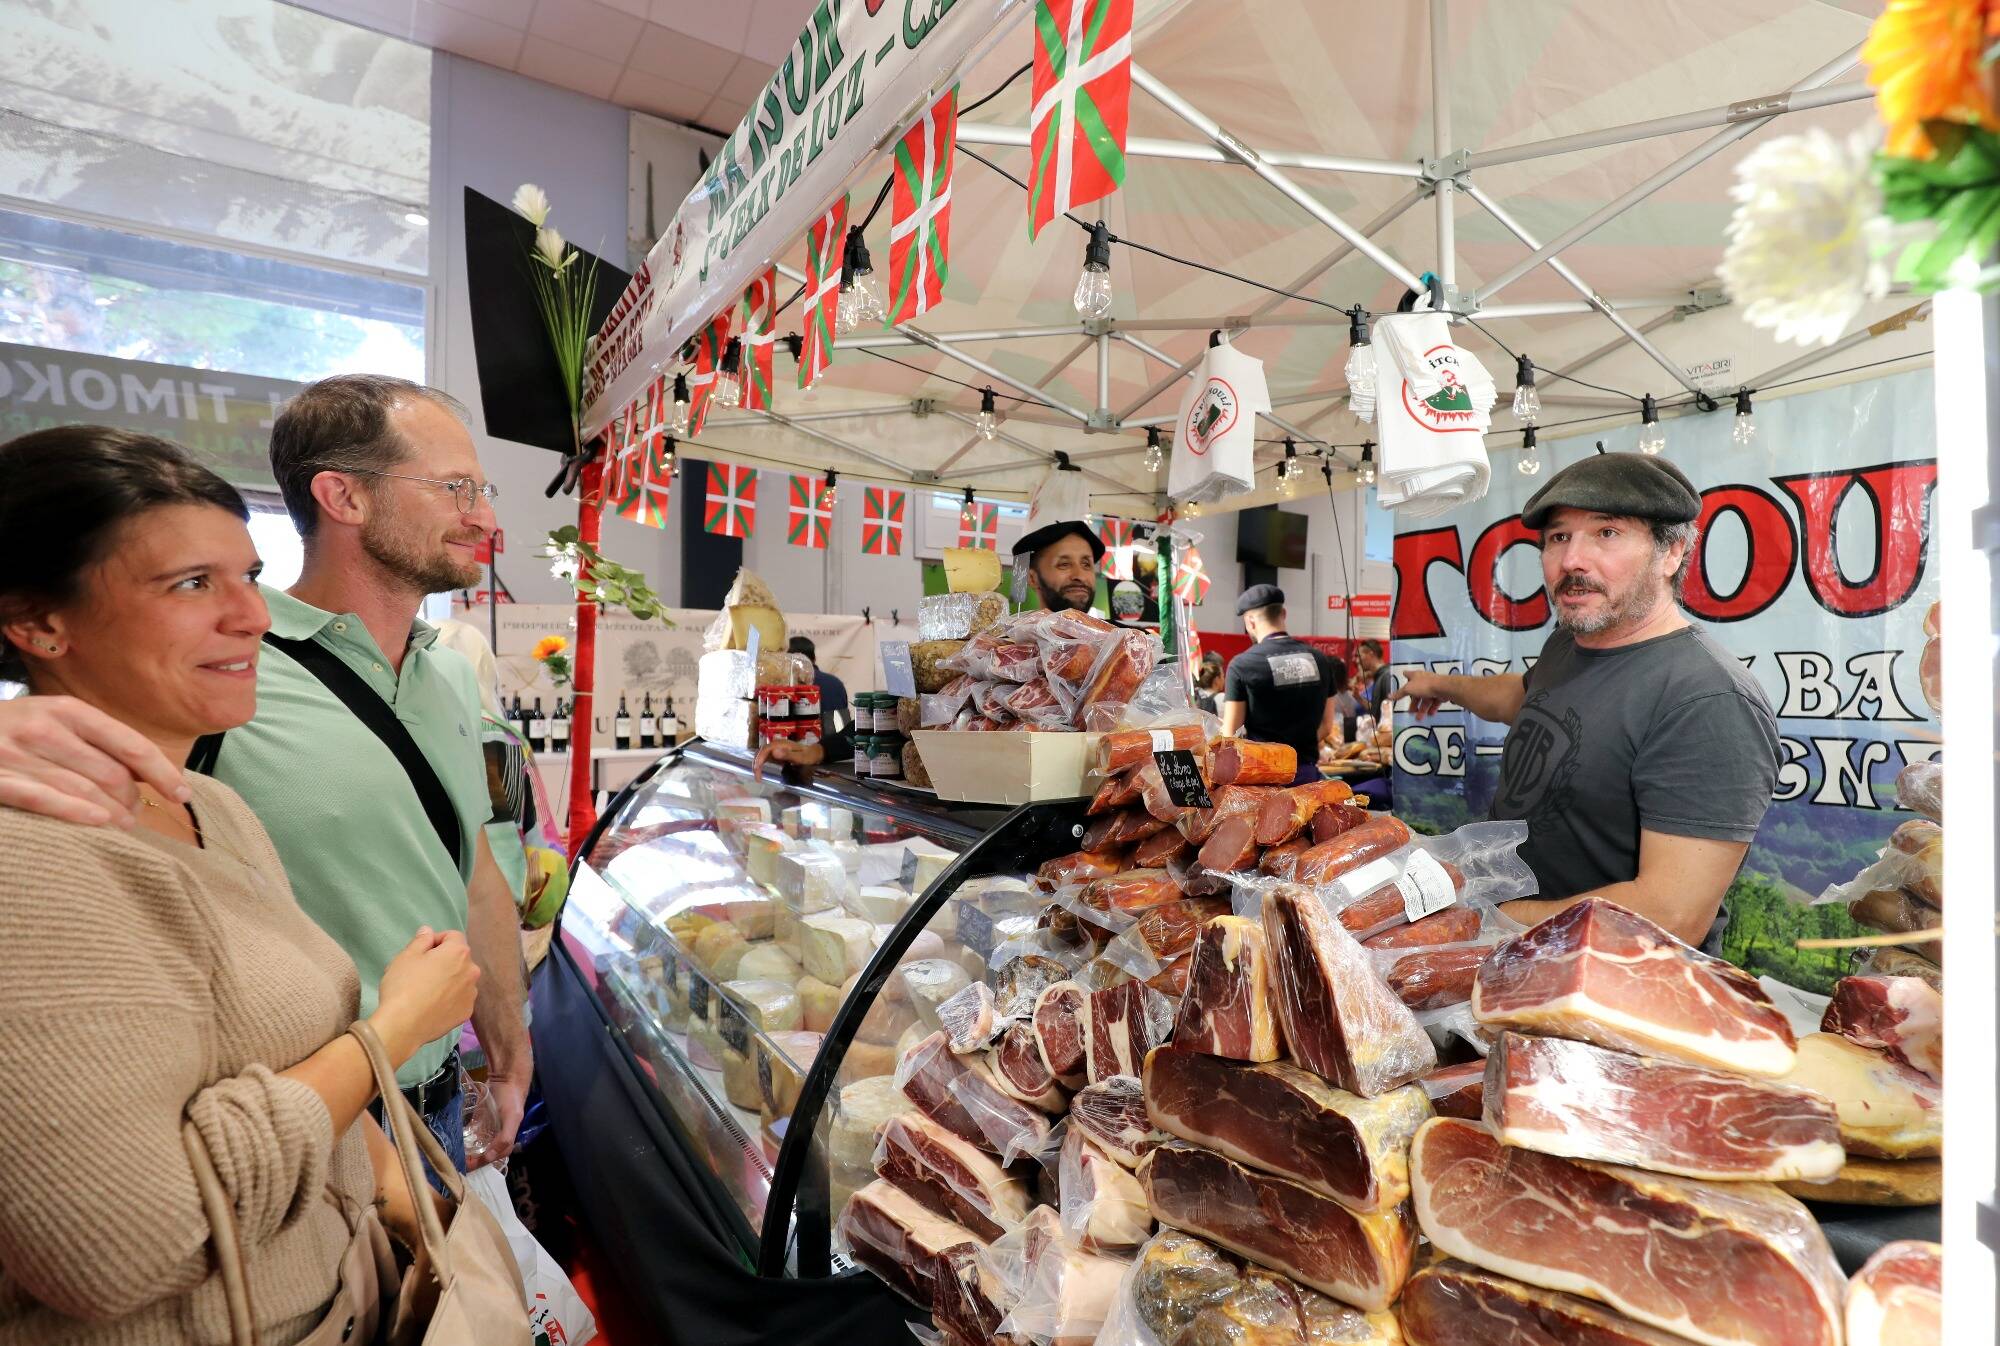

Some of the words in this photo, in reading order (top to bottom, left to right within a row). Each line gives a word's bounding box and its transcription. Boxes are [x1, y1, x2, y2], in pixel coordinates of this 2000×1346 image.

[775, 126, 807, 203] DE
[806, 49, 866, 167] LUZ
[1686, 359, 1731, 375] VITABRI
[1392, 457, 1941, 639] TCOU
[1394, 725, 1466, 777] CE
